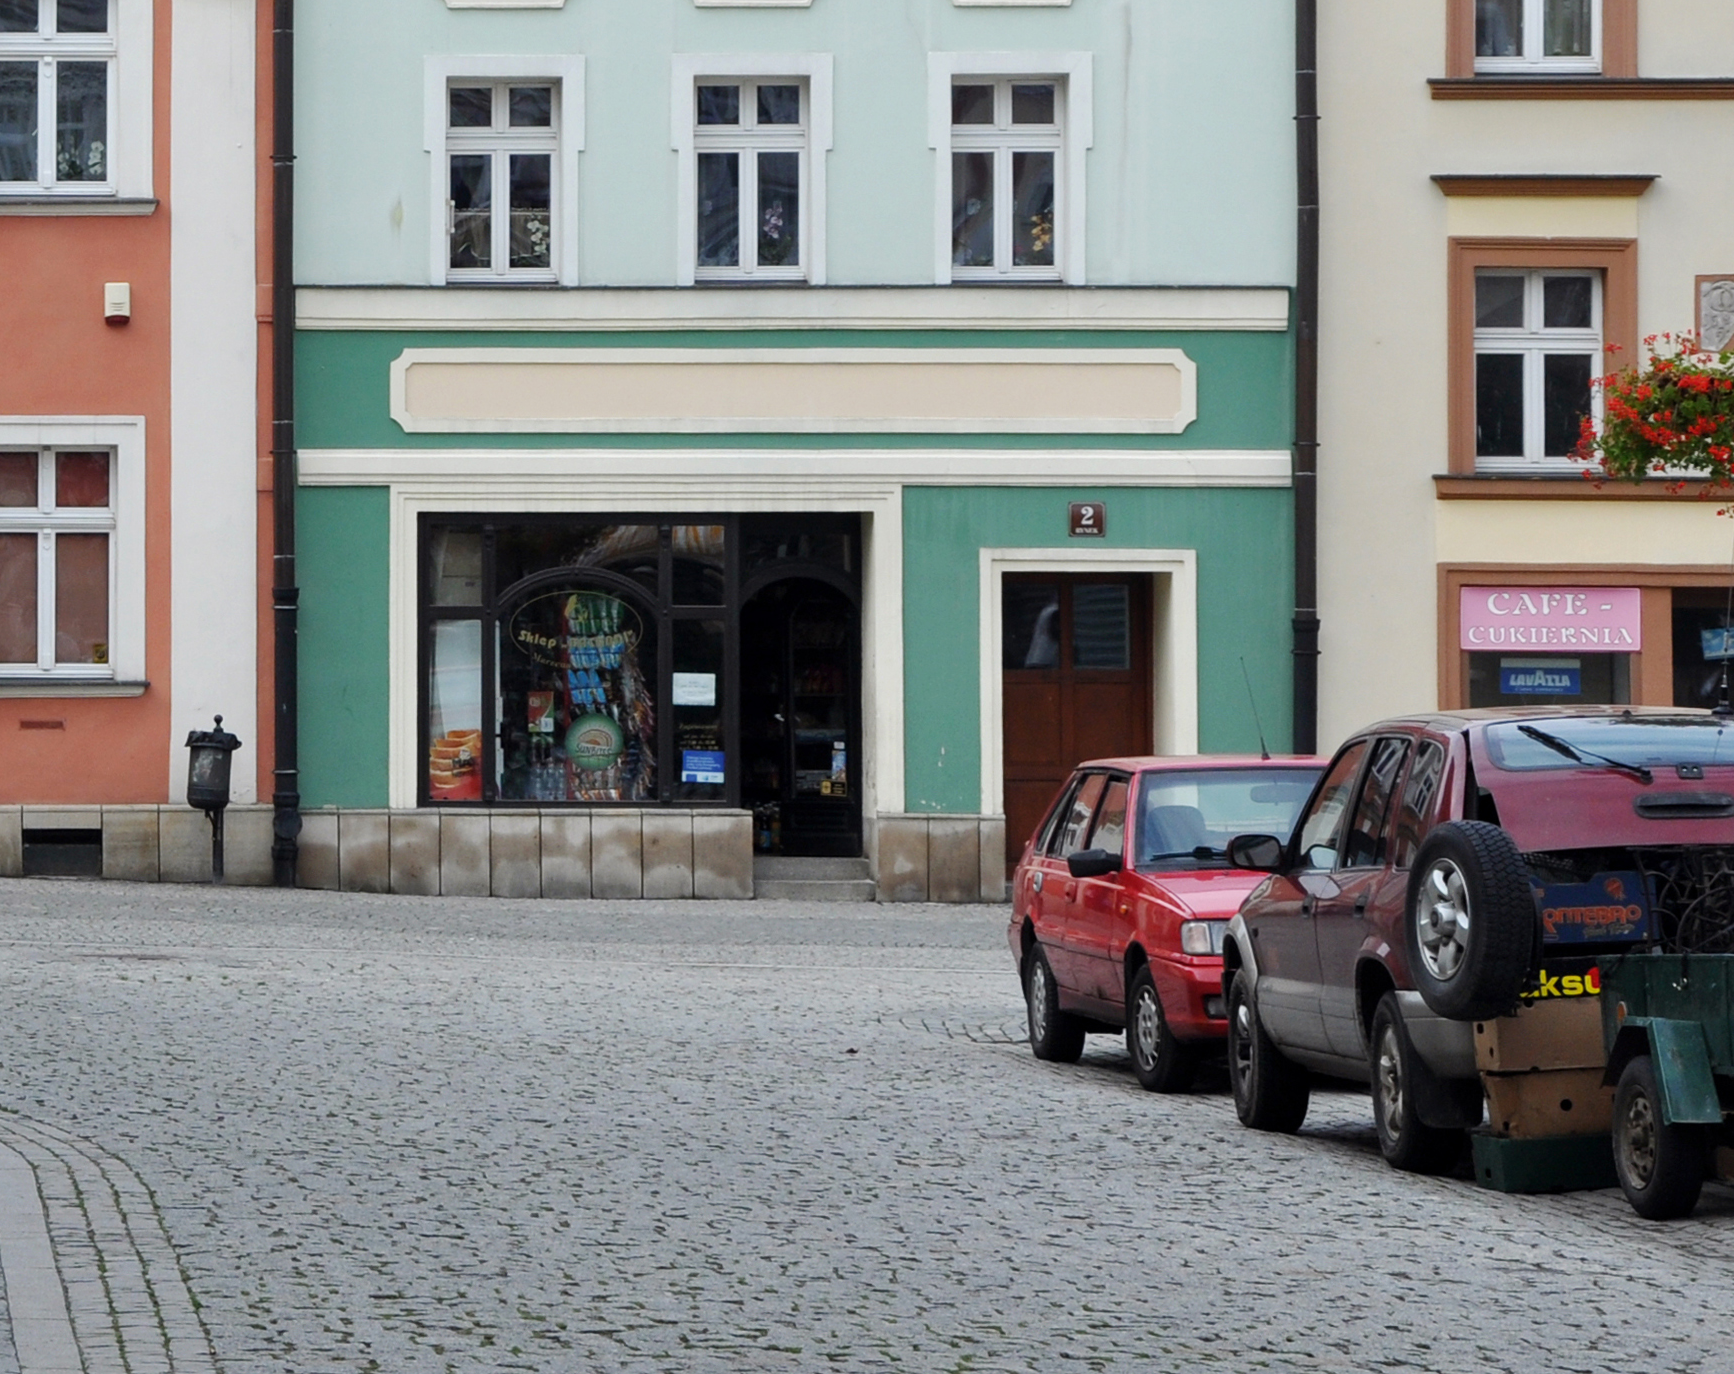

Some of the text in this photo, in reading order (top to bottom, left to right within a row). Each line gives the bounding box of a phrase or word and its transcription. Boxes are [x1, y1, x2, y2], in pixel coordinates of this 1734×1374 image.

[1080, 506, 1094, 525] 2
[1487, 592, 1587, 616] CAFE
[518, 629, 557, 649] Sklep
[1468, 627, 1634, 645] CUKIERNIA
[1509, 669, 1571, 687] LAVAZZA
